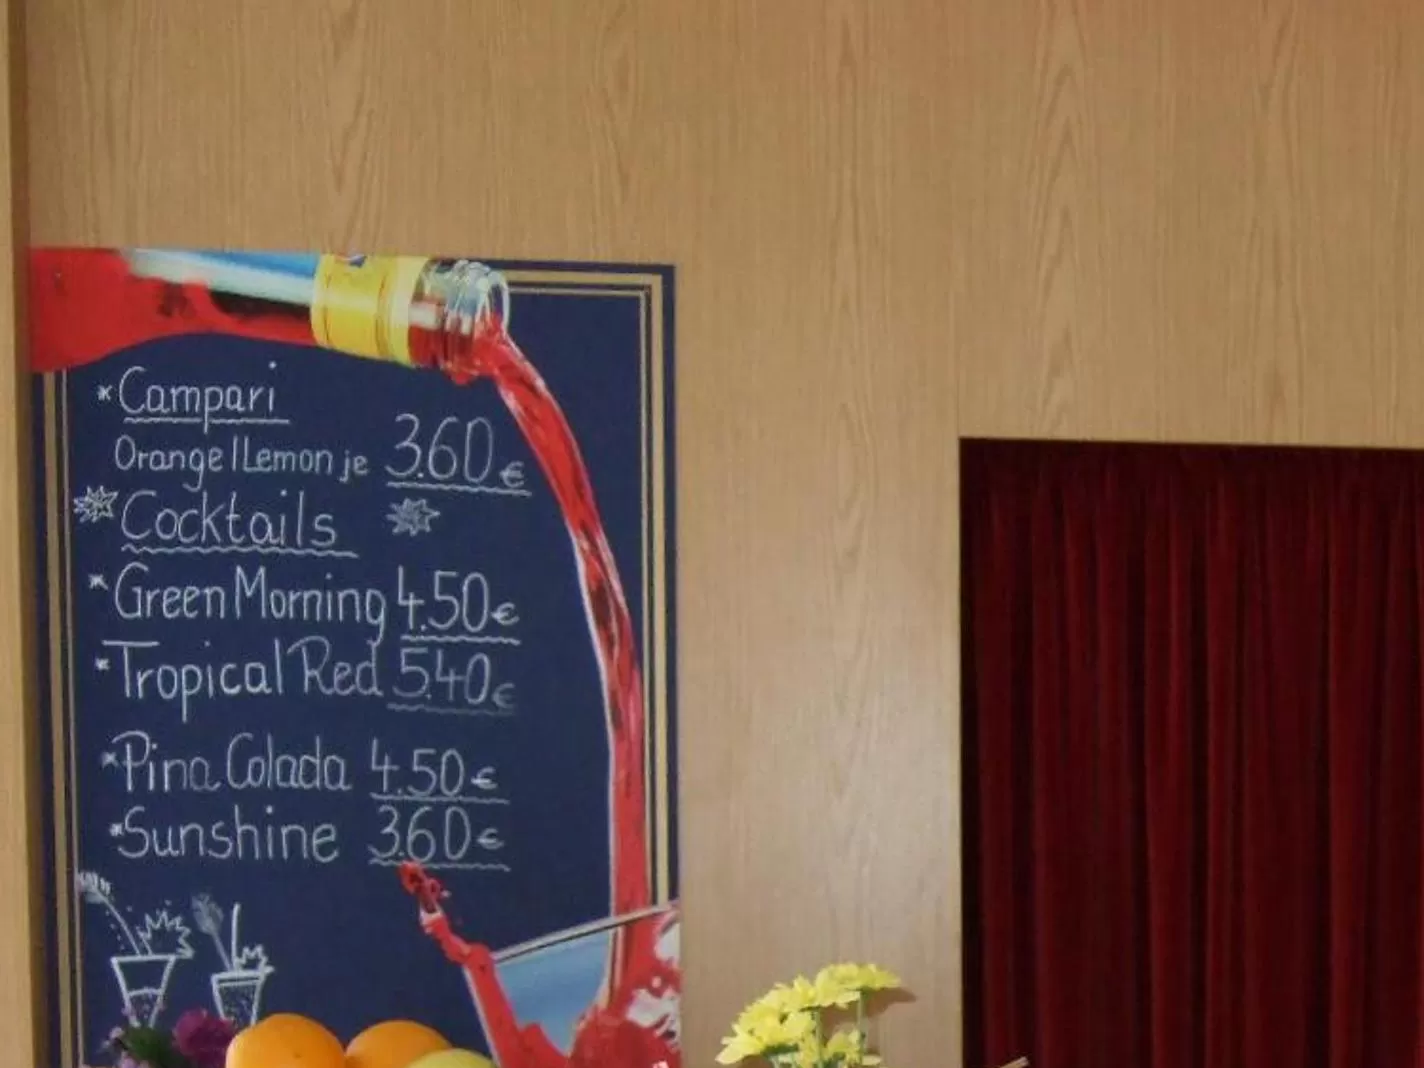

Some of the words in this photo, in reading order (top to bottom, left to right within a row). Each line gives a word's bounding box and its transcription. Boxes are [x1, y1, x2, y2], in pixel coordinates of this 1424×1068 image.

[119, 361, 275, 433] Campari
[339, 449, 370, 484] je
[120, 489, 337, 547] Cocktails
[115, 562, 225, 620] Green
[234, 565, 387, 646] Morning
[102, 638, 285, 723] Tropical
[287, 636, 383, 697] Red
[112, 730, 221, 792] Pina
[226, 732, 352, 793] Colada
[117, 804, 340, 863] Sunshine
